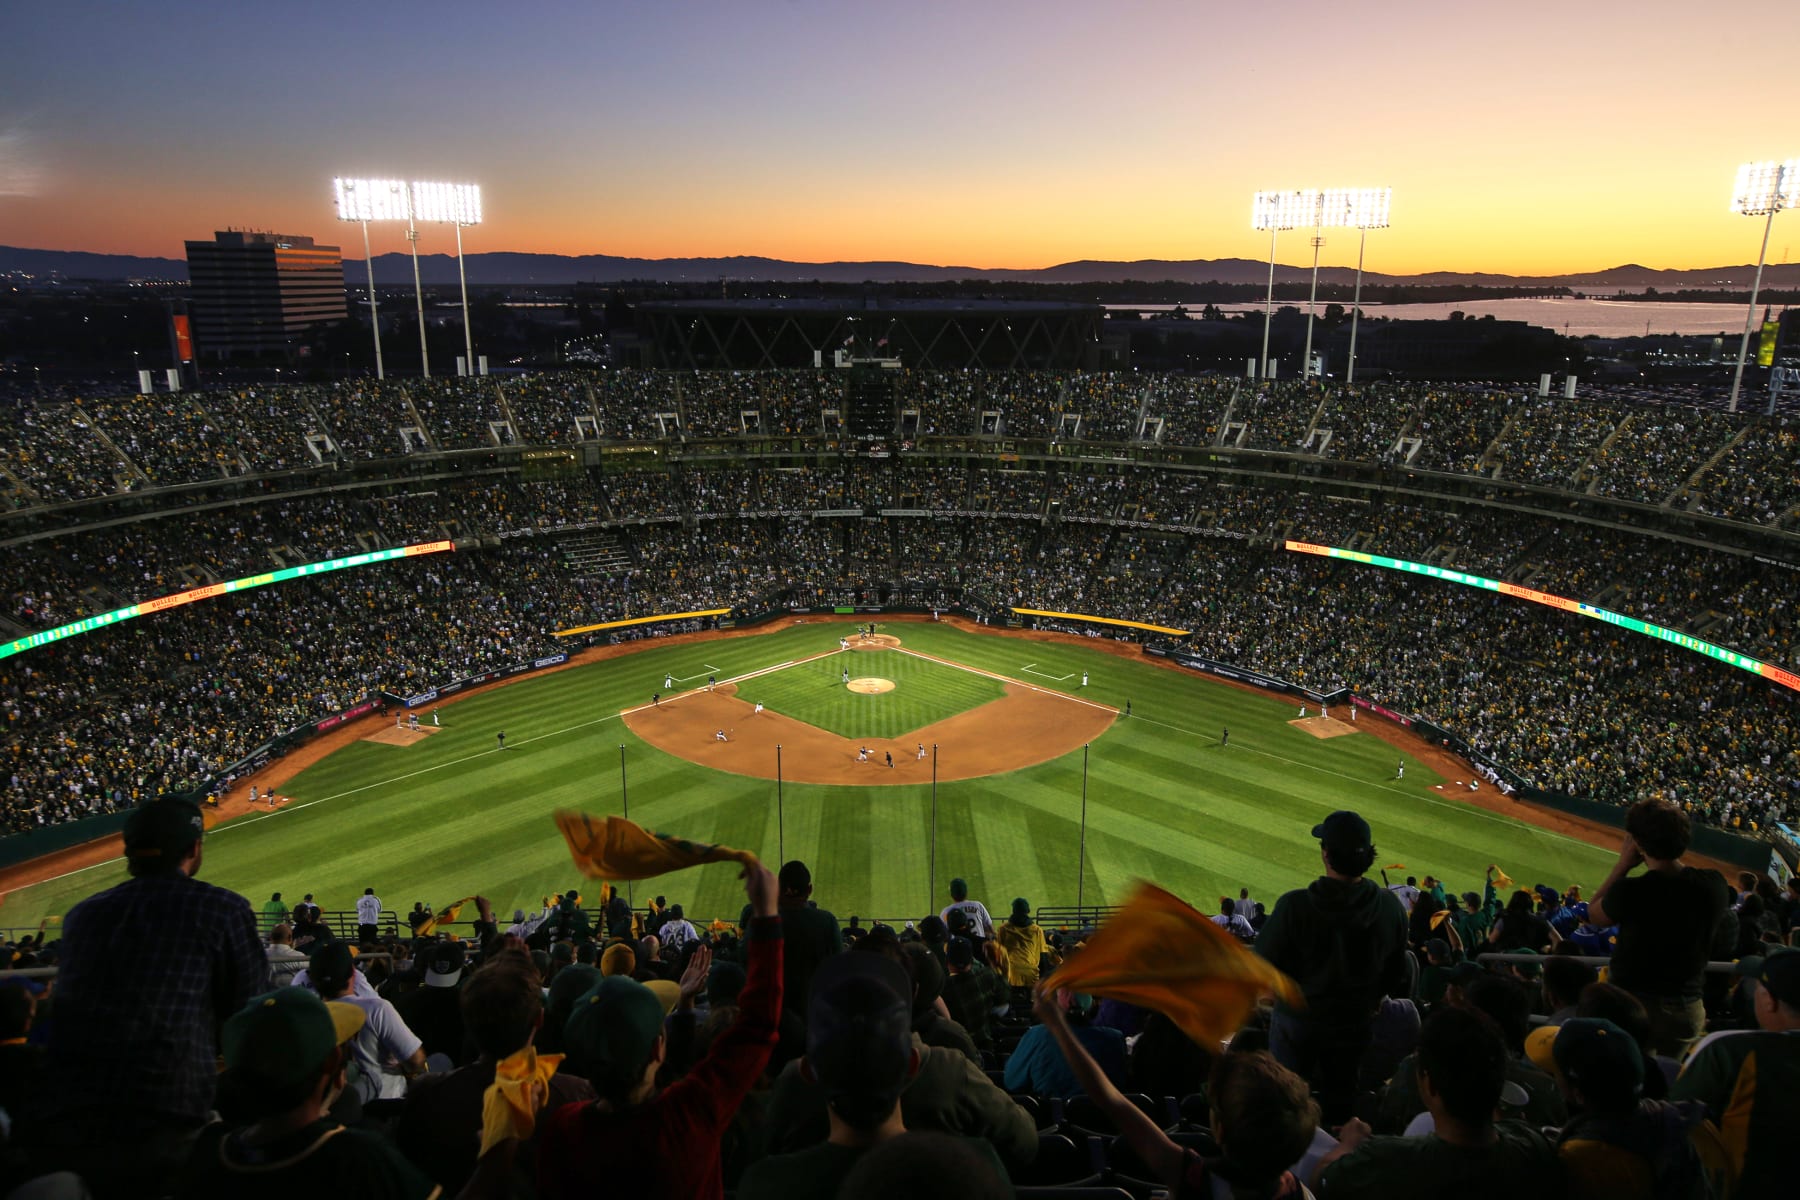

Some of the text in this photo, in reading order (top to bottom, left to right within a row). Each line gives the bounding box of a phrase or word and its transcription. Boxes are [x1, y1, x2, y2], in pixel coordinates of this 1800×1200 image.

[152, 596, 178, 608] BULLEIT
[188, 587, 213, 599] BULLEIT
[1510, 586, 1533, 598] BULLEIT
[1542, 595, 1567, 606] BULLEIT
[535, 655, 564, 667] GEICO
[408, 691, 437, 707] GEICO
